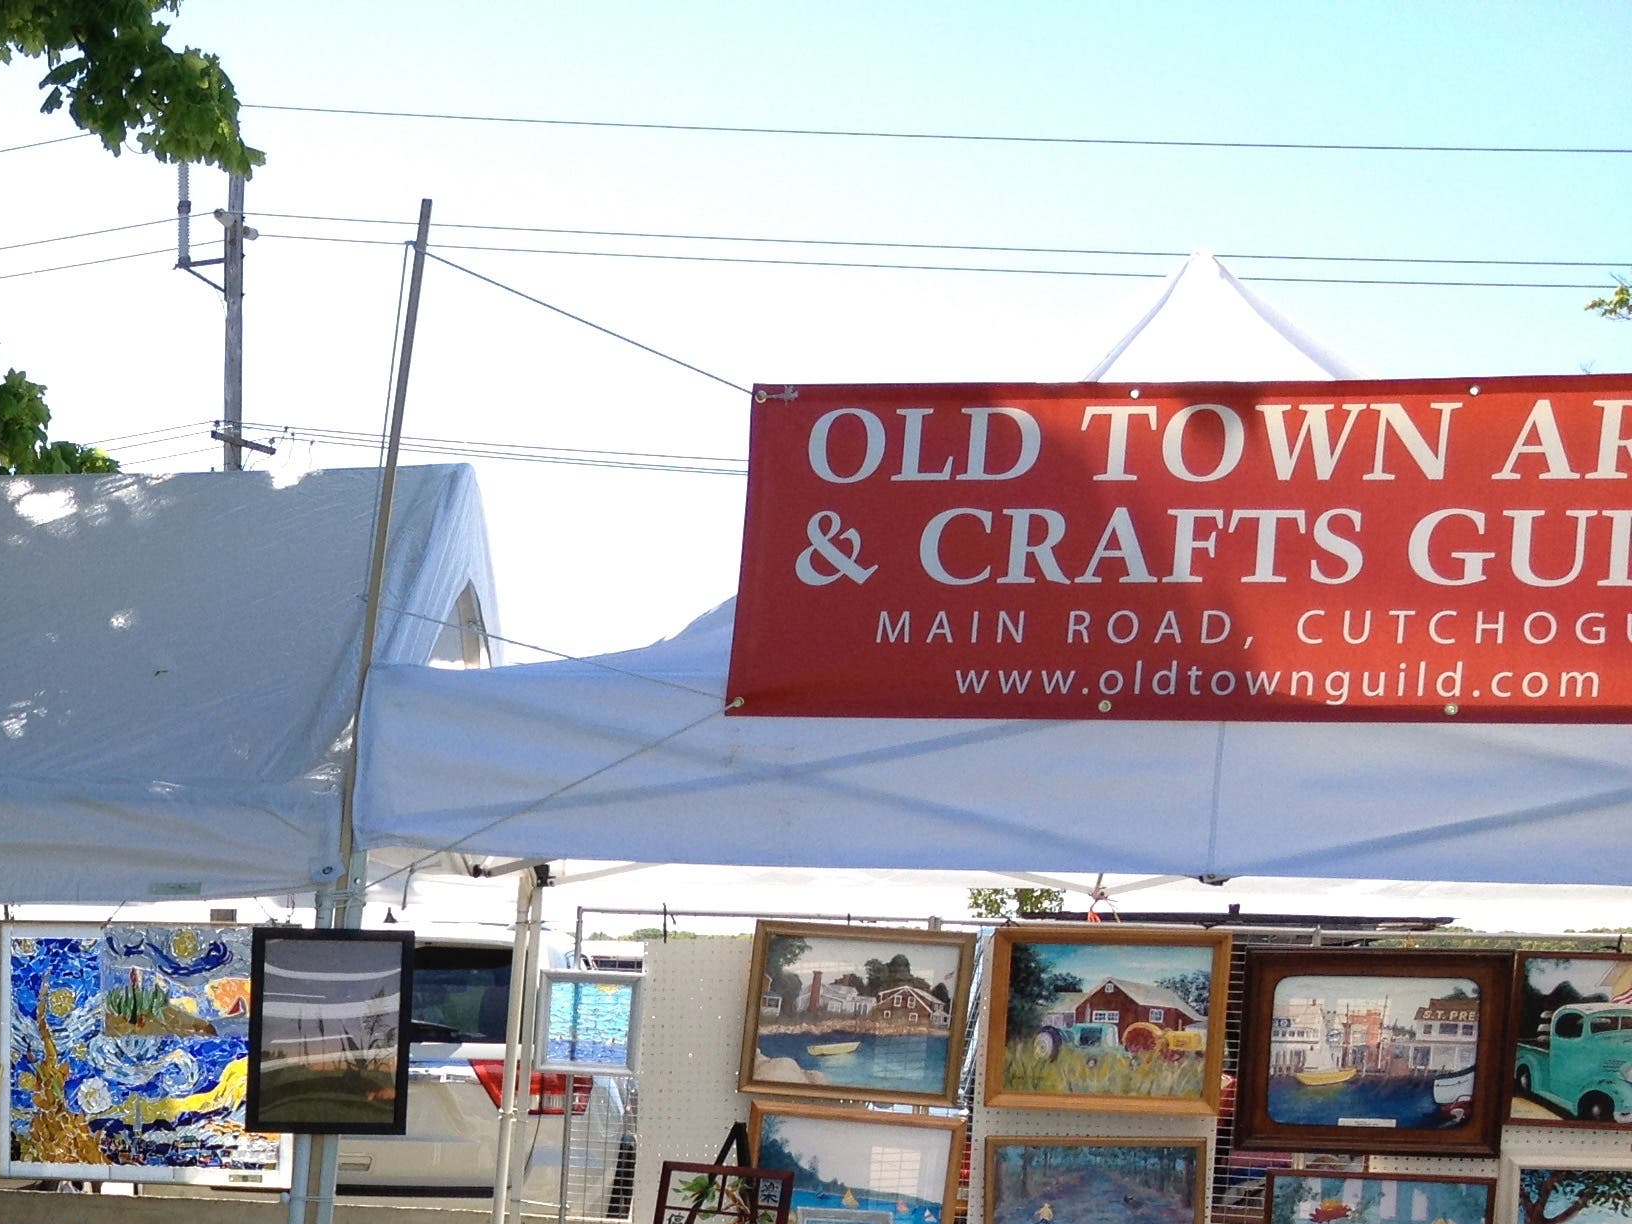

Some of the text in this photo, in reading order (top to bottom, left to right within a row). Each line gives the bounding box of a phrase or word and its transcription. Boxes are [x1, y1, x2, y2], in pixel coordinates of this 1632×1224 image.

[808, 406, 1041, 484] OLD
[1081, 402, 1463, 483] TOWN
[795, 506, 1632, 588] & CRAFTS GUI
[876, 609, 1632, 649] MAIN ROAD, CUTCHOG
[955, 660, 1600, 706] www.oldtownguild.com
